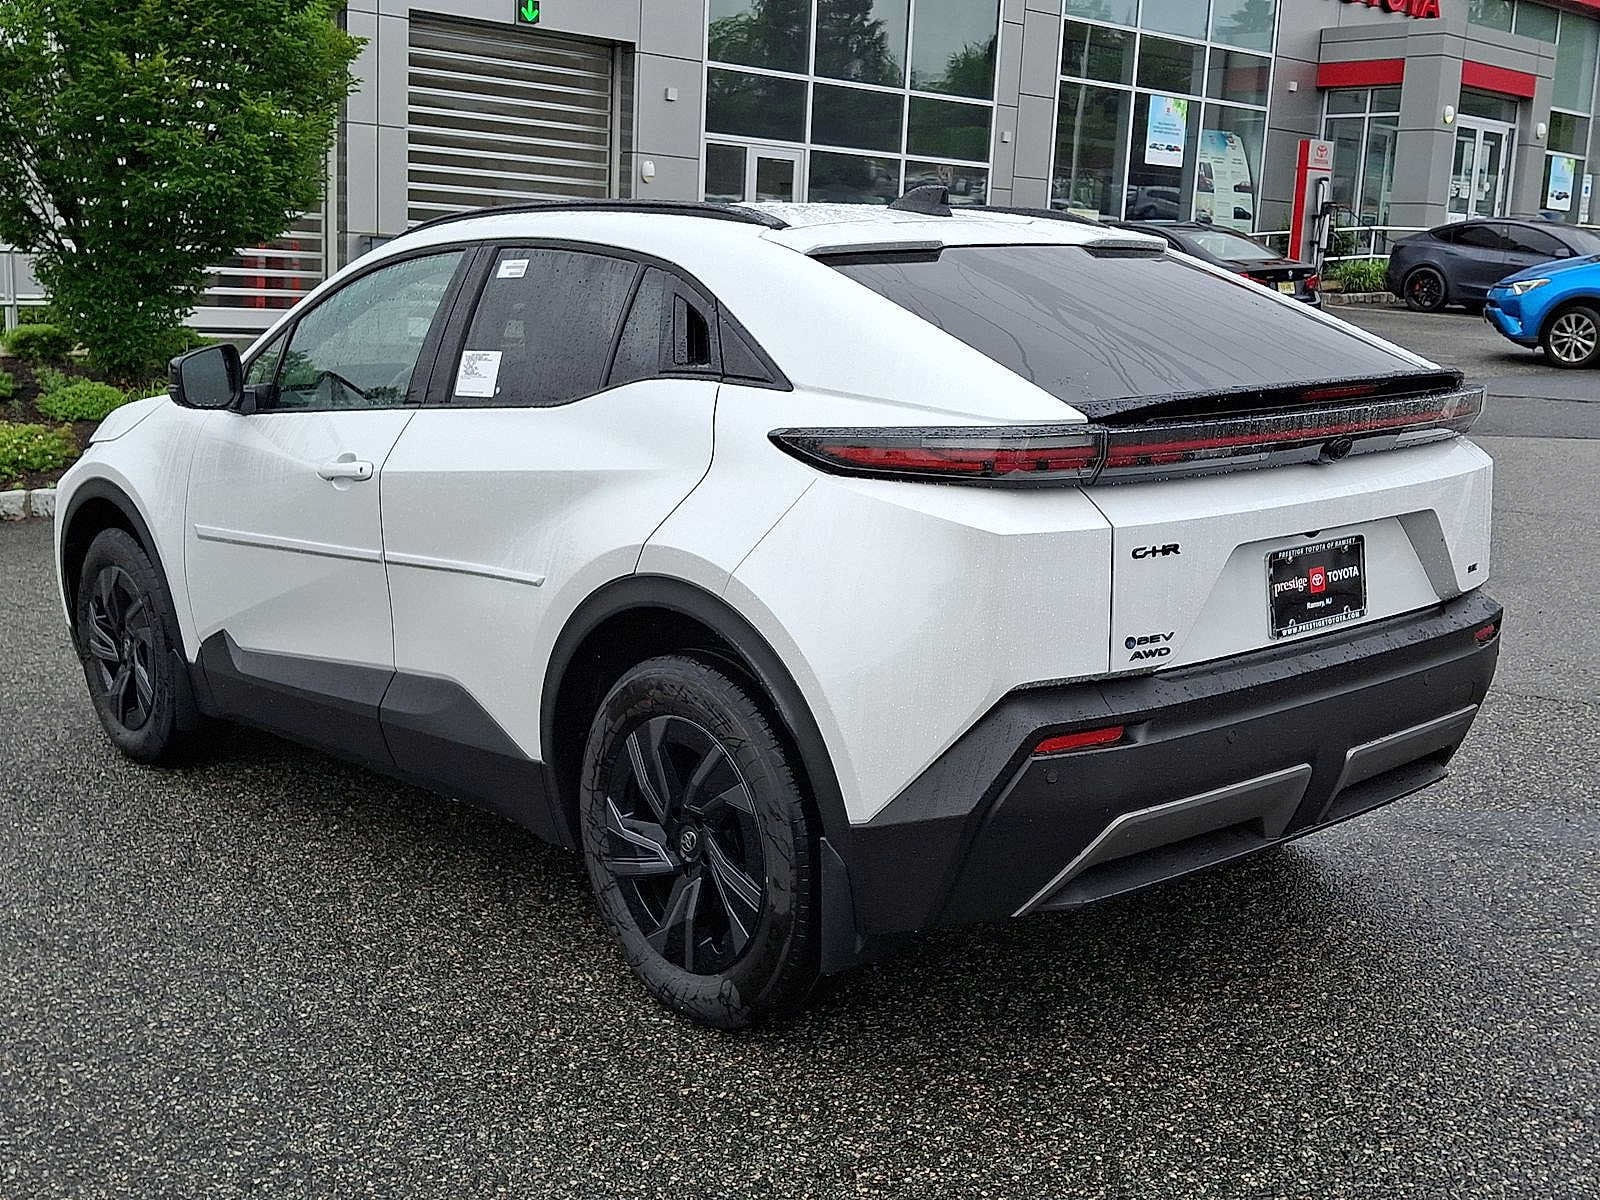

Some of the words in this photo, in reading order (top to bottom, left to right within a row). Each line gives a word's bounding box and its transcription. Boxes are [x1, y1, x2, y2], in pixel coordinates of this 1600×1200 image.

[1341, 0, 1440, 19] OTA
[1279, 547, 1304, 559] PRESTIGE
[1305, 544, 1326, 554] TOYOTA
[1274, 576, 1308, 597] prestige
[1327, 566, 1360, 583] TOYOTA
[1137, 631, 1175, 646] BEV
[1129, 647, 1171, 662] AWD
